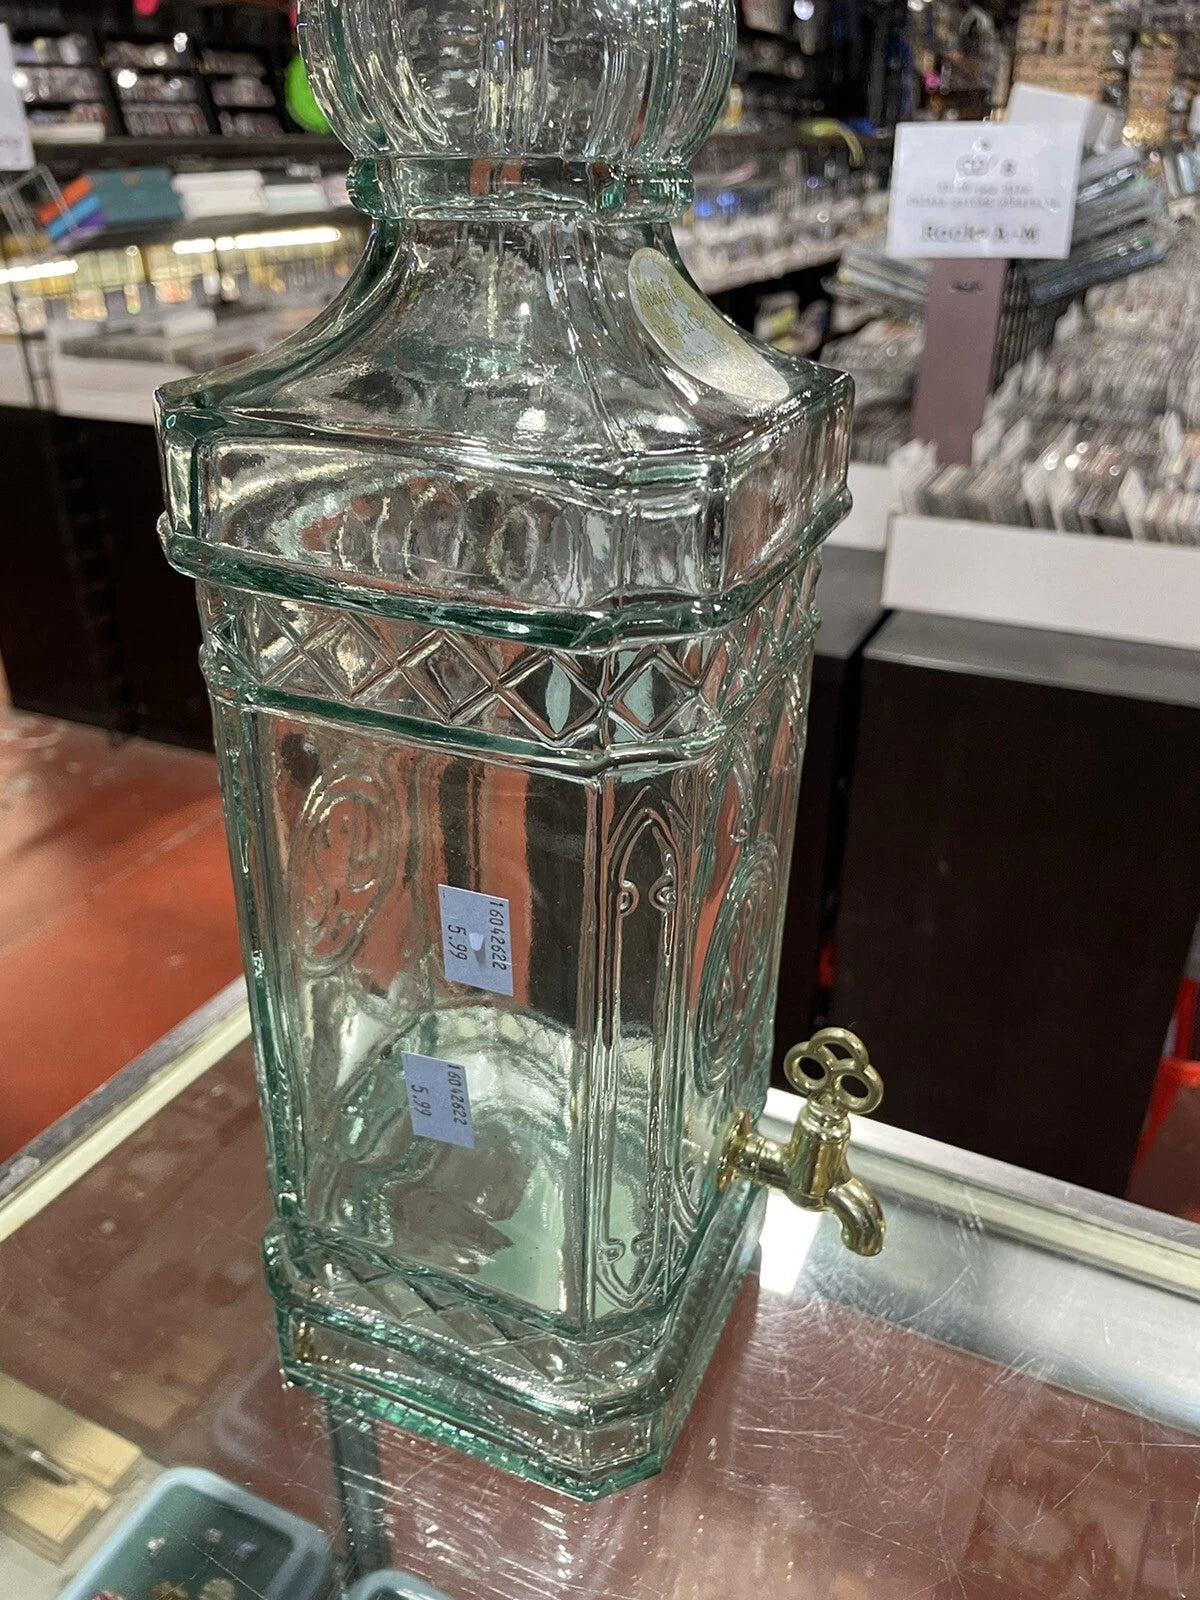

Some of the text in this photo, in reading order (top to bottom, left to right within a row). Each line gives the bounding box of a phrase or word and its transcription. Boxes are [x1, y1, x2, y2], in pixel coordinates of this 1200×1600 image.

[447, 924, 468, 961] 5.99
[489, 901, 507, 970] 16042622
[411, 1084, 432, 1117] 5.99
[447, 1064, 467, 1125] 16042622
